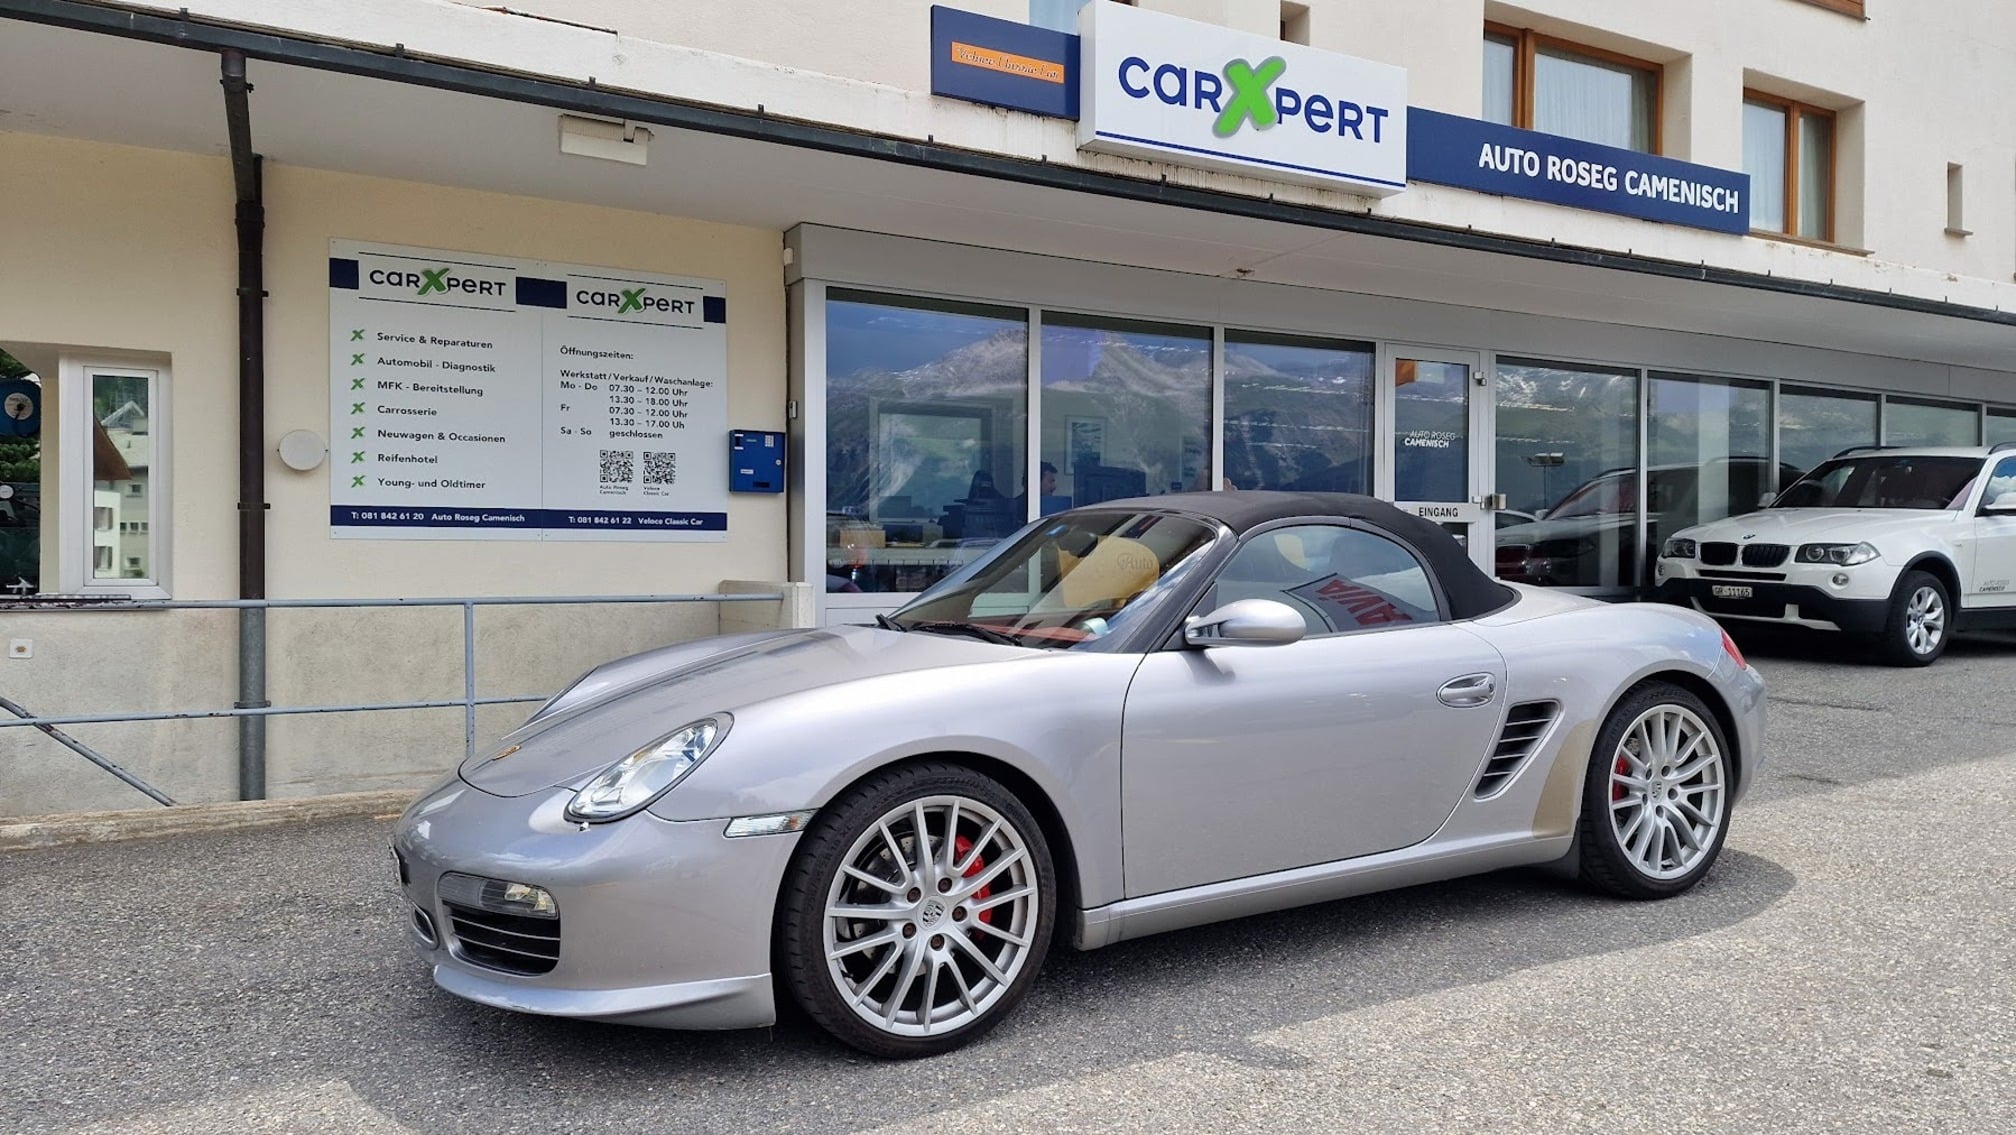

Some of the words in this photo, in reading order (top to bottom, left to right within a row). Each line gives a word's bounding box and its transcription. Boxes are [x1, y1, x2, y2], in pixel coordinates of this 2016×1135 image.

[1479, 143, 1540, 177] AUTO
[1547, 156, 1618, 192] ROSEG
[1624, 170, 1739, 214] CAMENISCH
[377, 332, 415, 343] Service
[419, 336, 426, 344] &
[430, 336, 492, 349] Reparaturen
[560, 345, 634, 360] Öffnungszeiten:
[377, 357, 432, 368] Automobil
[442, 361, 496, 372] Diagnostik
[377, 381, 402, 390] MFK
[413, 383, 483, 397] Bereitstellung
[560, 381, 576, 390] Mo
[584, 383, 598, 391] Do
[609, 384, 635, 394] 07.30
[646, 387, 670, 396] 12.00
[672, 388, 688, 396] Uhr
[609, 395, 635, 404] 13.30
[646, 398, 670, 407] 18.00
[672, 399, 688, 407] Uhr
[377, 405, 437, 416] Carrosserie
[560, 404, 570, 412] Fr
[609, 406, 635, 415] 07.30
[646, 409, 670, 417] 12.00
[672, 410, 688, 418] Uhr
[609, 418, 635, 426] 13.30
[646, 420, 670, 428] 17.00
[377, 430, 434, 441] Neuwagen
[437, 432, 445, 441] &
[448, 433, 506, 443] Occasionen
[560, 426, 572, 435] Sa
[580, 427, 592, 435] So
[609, 429, 663, 439] geschlossen
[1409, 429, 1430, 439] AUTO
[1431, 431, 1456, 441] ROSEG
[1404, 437, 1449, 448] CAMENISCH
[377, 454, 438, 464] Reifenhotel
[377, 478, 415, 489] Young-
[418, 480, 437, 488] und
[441, 480, 486, 489] Oldtimer
[351, 512, 359, 520] T:
[361, 512, 378, 520] 081
[431, 513, 452, 521] Auto
[455, 514, 480, 523] Roseg
[482, 514, 525, 522] Camenisch
[1418, 507, 1458, 517] EINGANG
[577, 516, 592, 524] 081
[622, 517, 632, 525] 22
[638, 517, 663, 525] Veloce
[664, 518, 689, 526] Classic
[690, 518, 704, 526] Car
